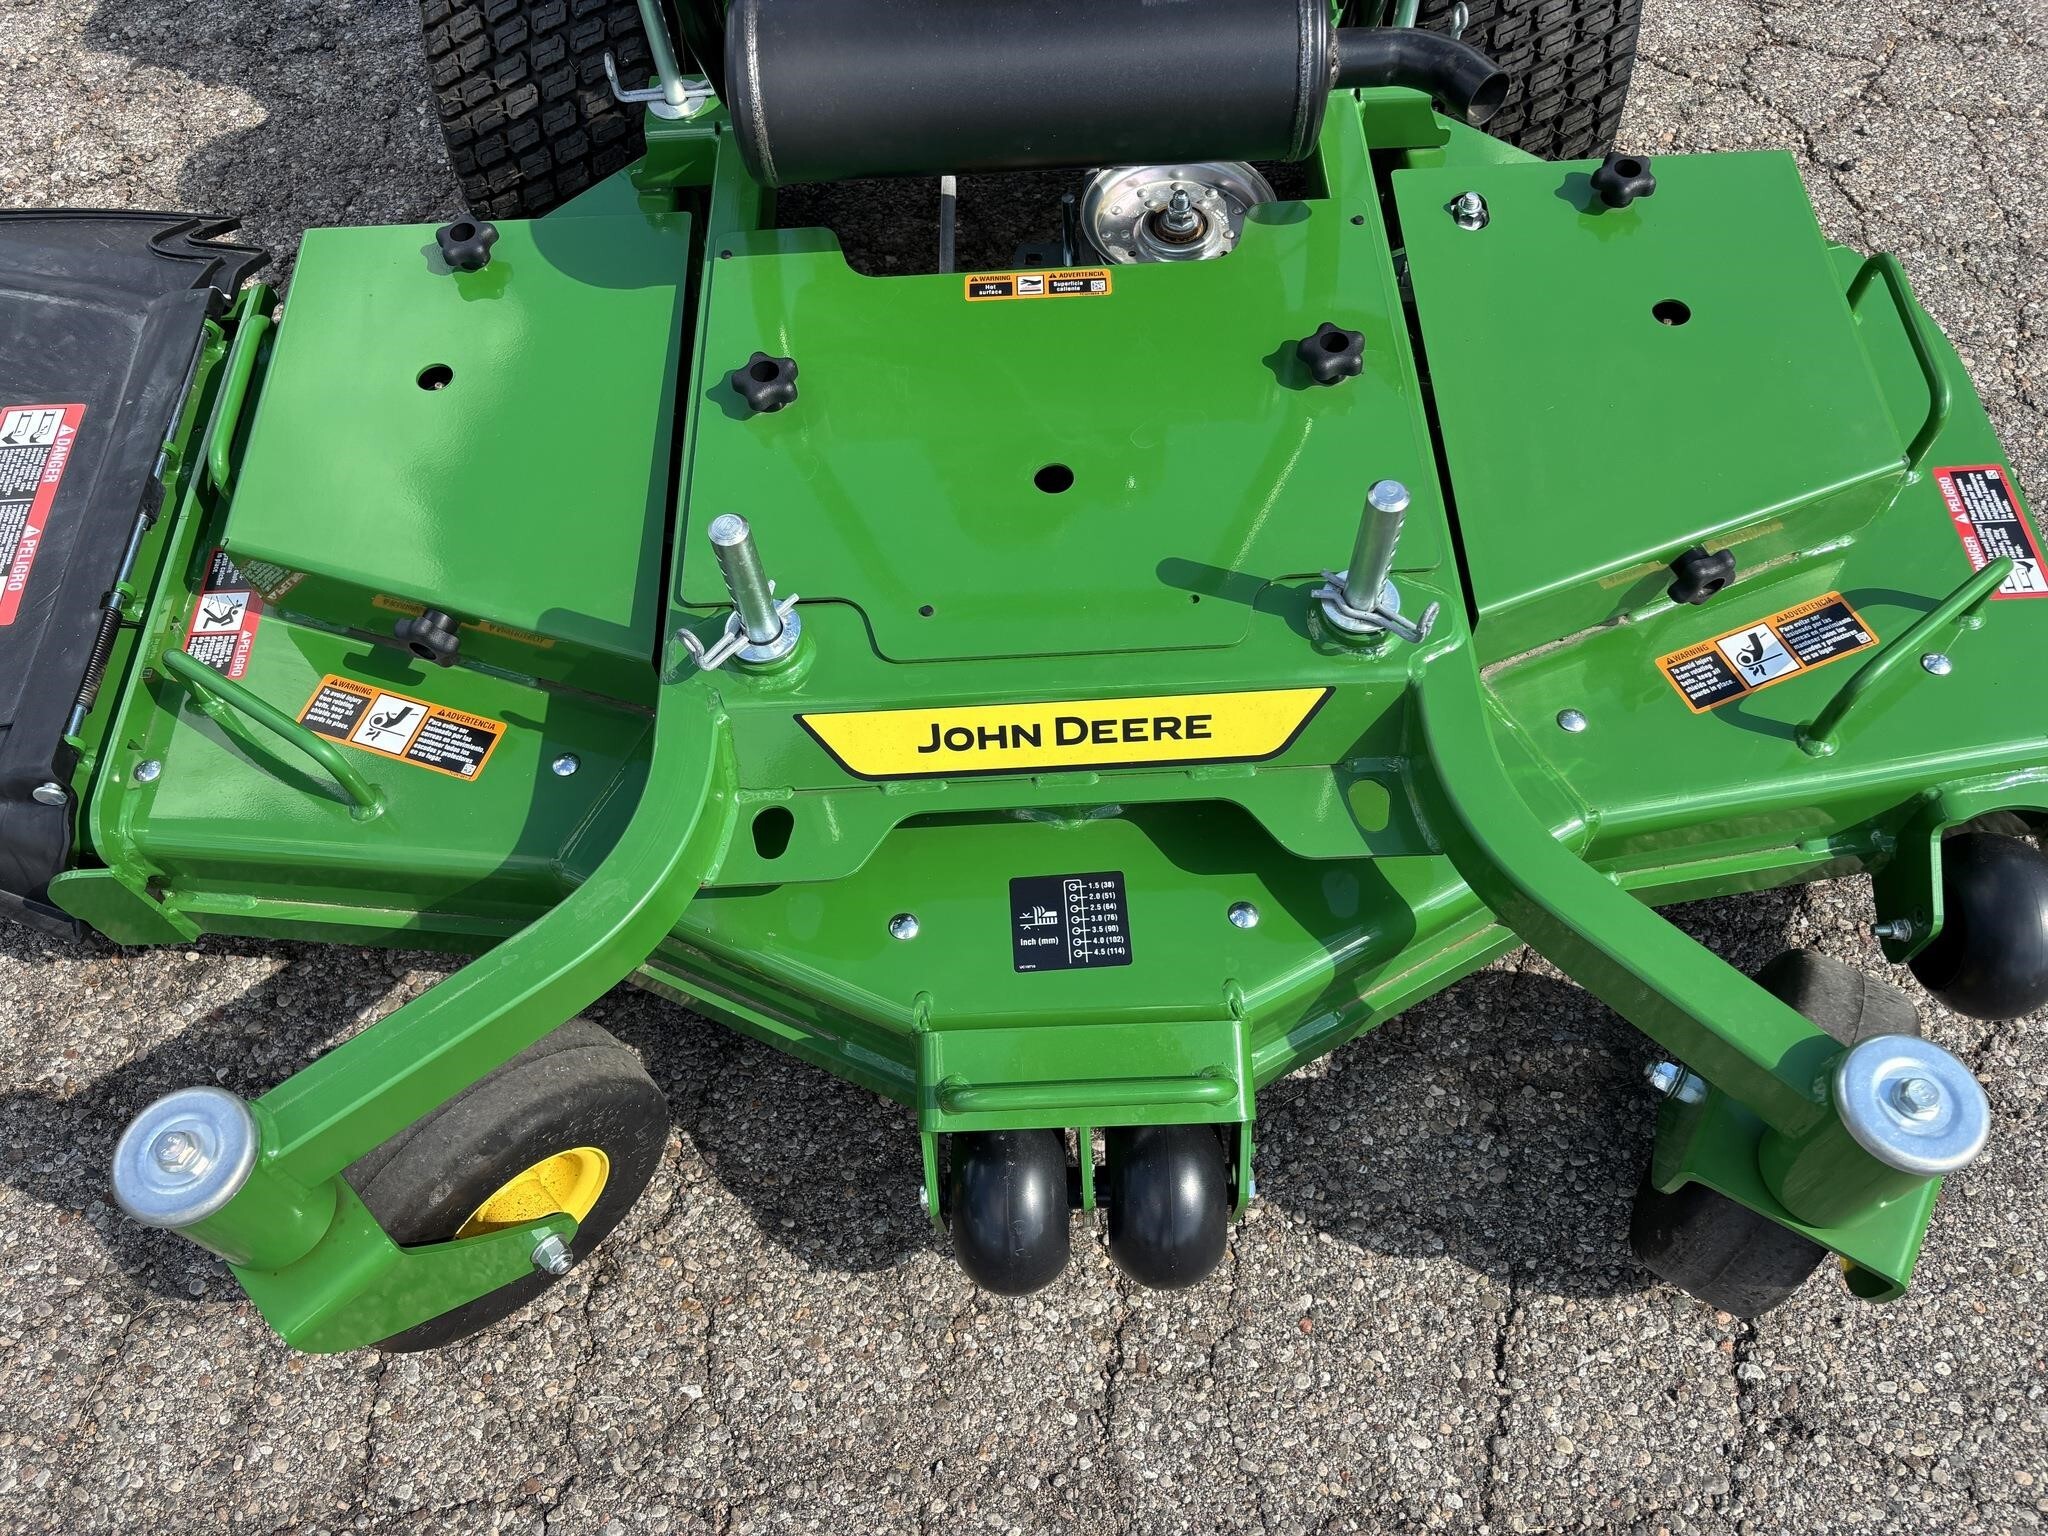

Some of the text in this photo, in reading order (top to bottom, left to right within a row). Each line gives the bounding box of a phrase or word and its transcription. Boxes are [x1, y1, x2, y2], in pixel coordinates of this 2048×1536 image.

[43, 438, 71, 482] DANGER
[1939, 477, 1963, 512] PELIGRO
[8, 540, 37, 591] PELIGRO
[1784, 597, 1834, 620] ADVERTENCIA
[231, 639, 250, 676] PELIGRO
[1672, 644, 1709, 661] WARNING
[338, 681, 372, 695] WARNING
[446, 712, 495, 730] ADVERTENCIA
[917, 714, 1213, 753] JOHN DEERE
[1088, 881, 1115, 889] 1.5 (38)
[1102, 892, 1116, 900] (51)
[1103, 903, 1117, 911] (64)
[1104, 914, 1118, 923] (76)
[1105, 925, 1119, 933] (90)
[1020, 937, 1059, 946] Inch (mm)
[1106, 936, 1124, 944] (102)
[1107, 947, 1126, 956] (114)
